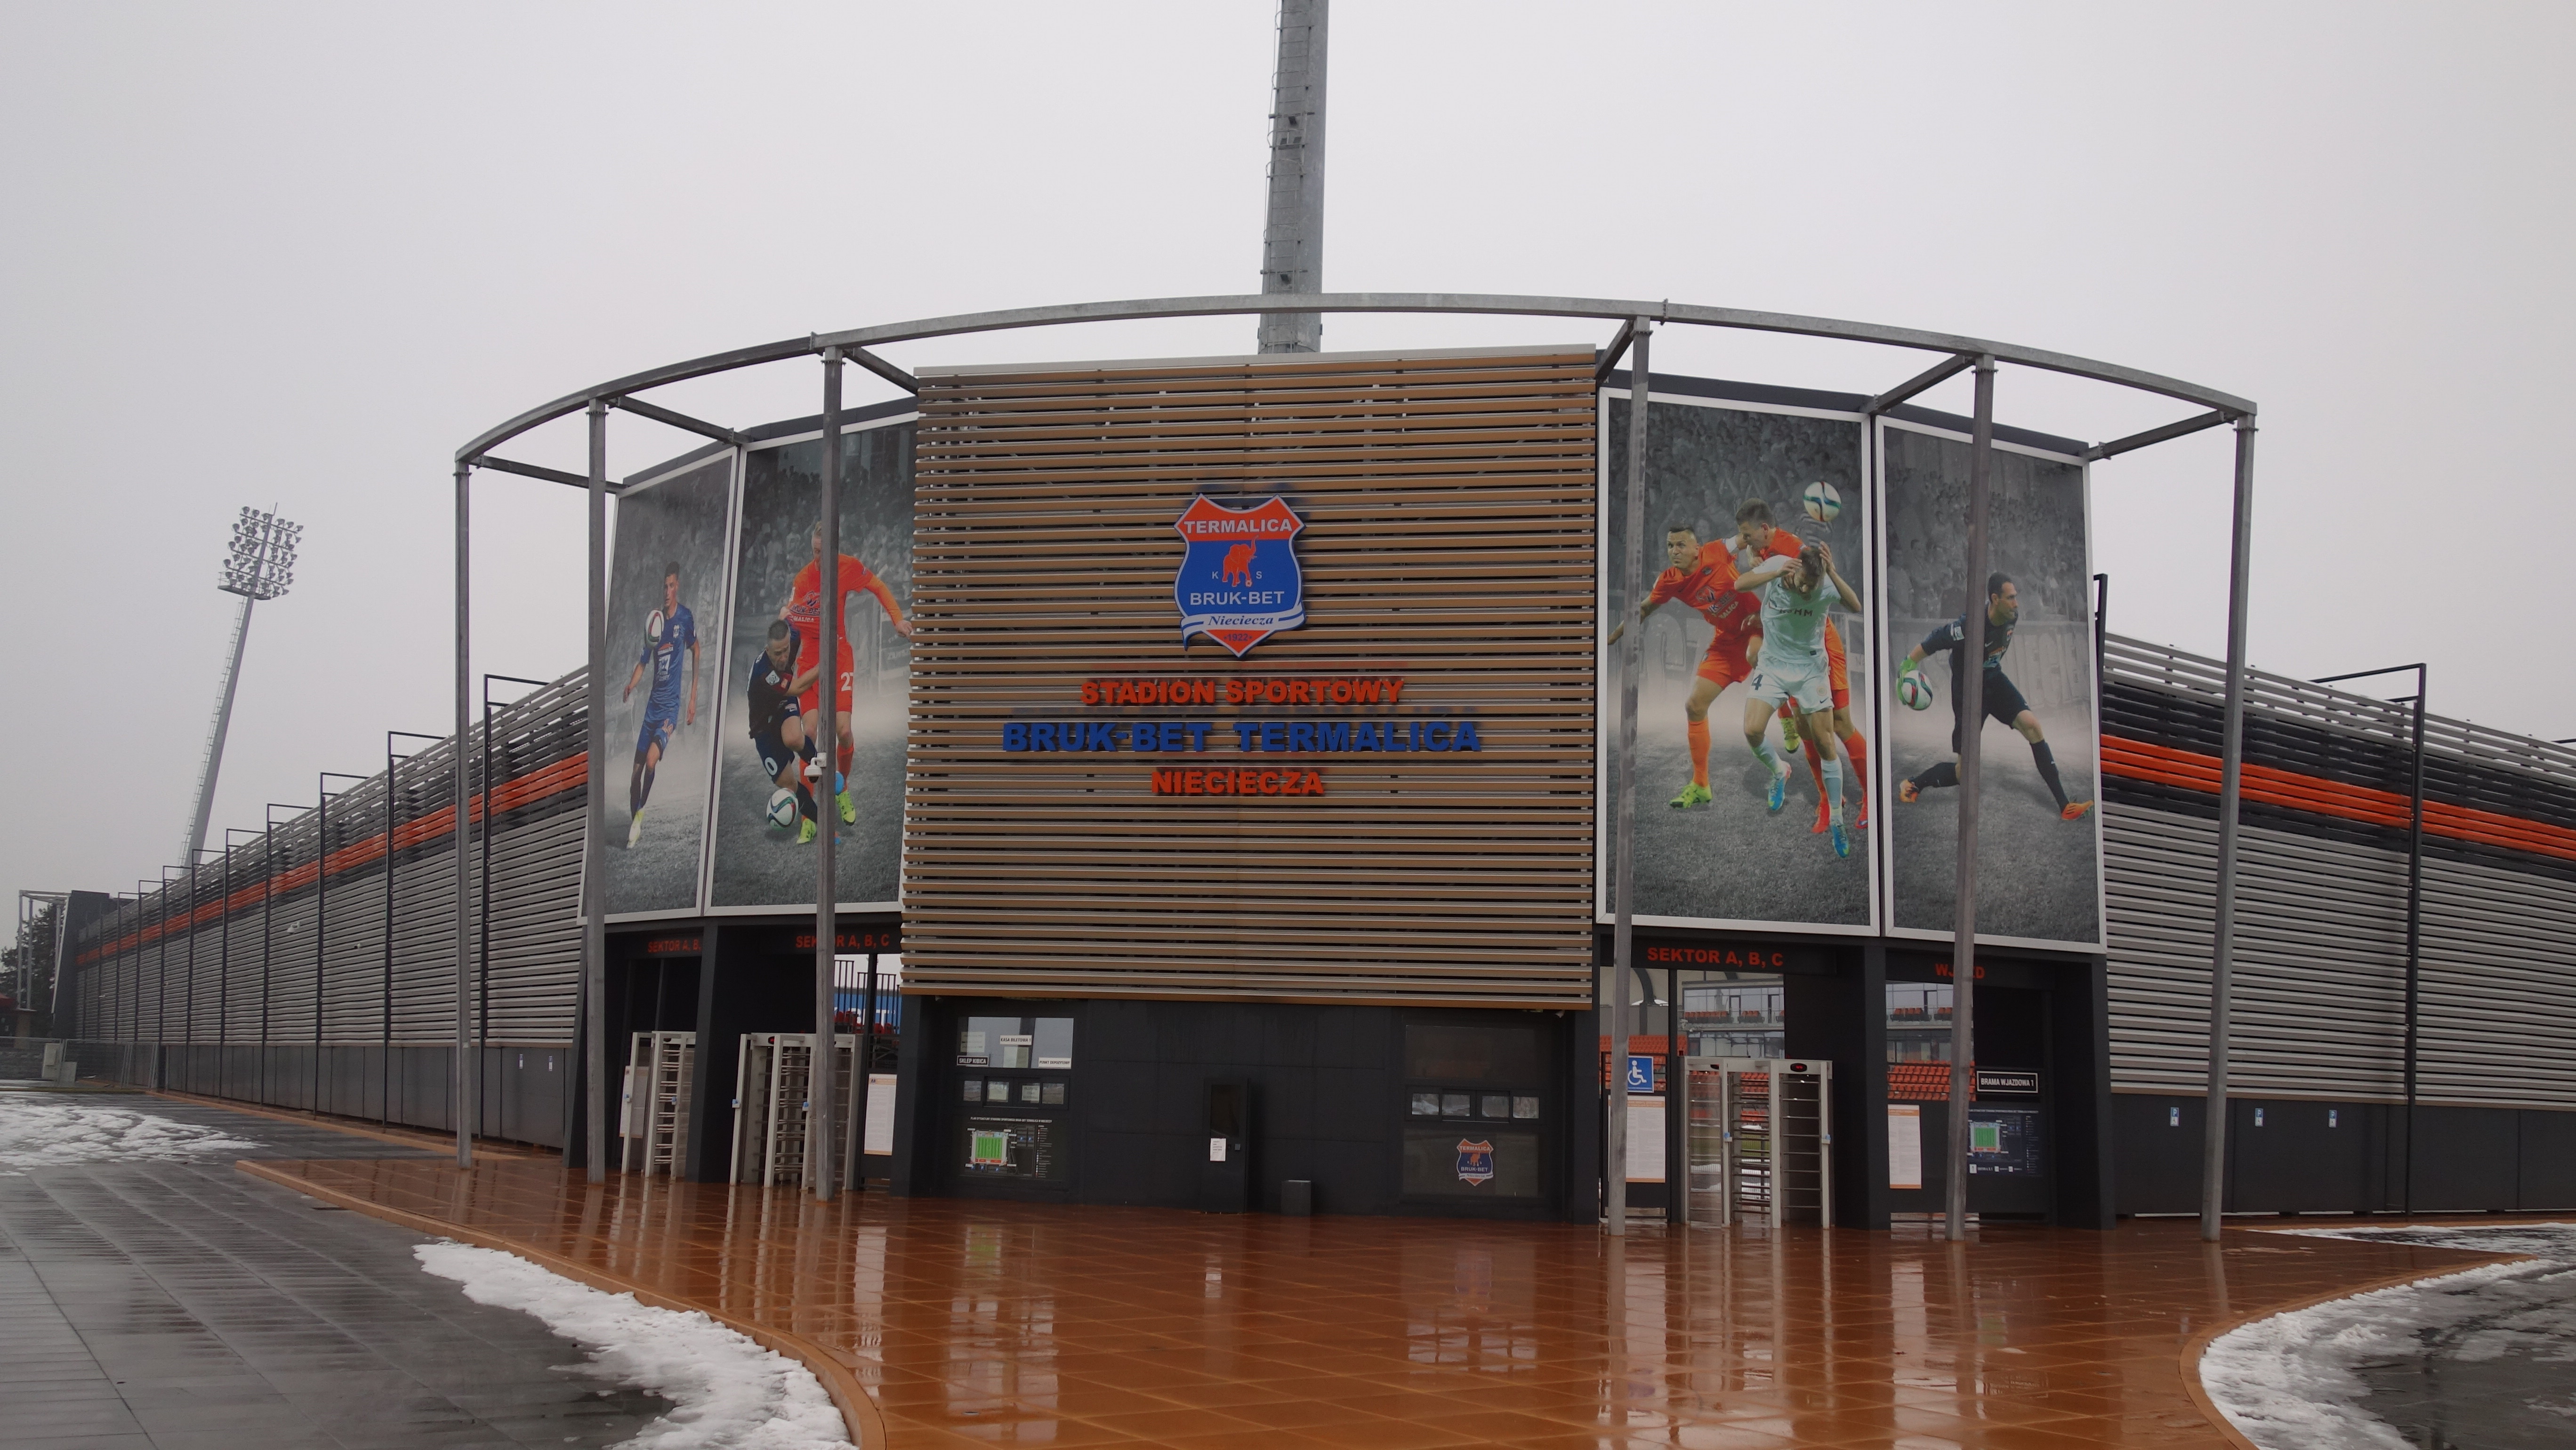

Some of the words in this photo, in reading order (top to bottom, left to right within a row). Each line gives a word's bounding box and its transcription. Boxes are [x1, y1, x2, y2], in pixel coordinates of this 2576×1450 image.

[1183, 518, 1292, 534] TERMALICA
[1212, 571, 1219, 579] K
[1256, 571, 1262, 579] S
[1190, 591, 1285, 605] BRUK-BET
[1208, 615, 1273, 626] Nieciecza
[1752, 674, 1763, 690] 4
[1080, 681, 1215, 704] STADION
[1225, 681, 1404, 704] SPORTOWY
[1003, 722, 1212, 752] BRUK-BET
[1233, 722, 1482, 752] TERMALICA
[1151, 771, 1325, 794] NIECIECZA
[647, 939, 680, 953] SEKTOR
[796, 934, 844, 948] SEKR
[848, 934, 861, 949] A,
[864, 934, 877, 949] B,
[880, 934, 890, 947] C
[1647, 947, 1721, 964] SEKTOR
[1725, 951, 1743, 967] A,
[1749, 952, 1766, 968] B,
[1771, 952, 1783, 967] C
[1980, 1077, 2000, 1086] BRAMA
[2000, 1078, 2029, 1087] WJAZDOWA
